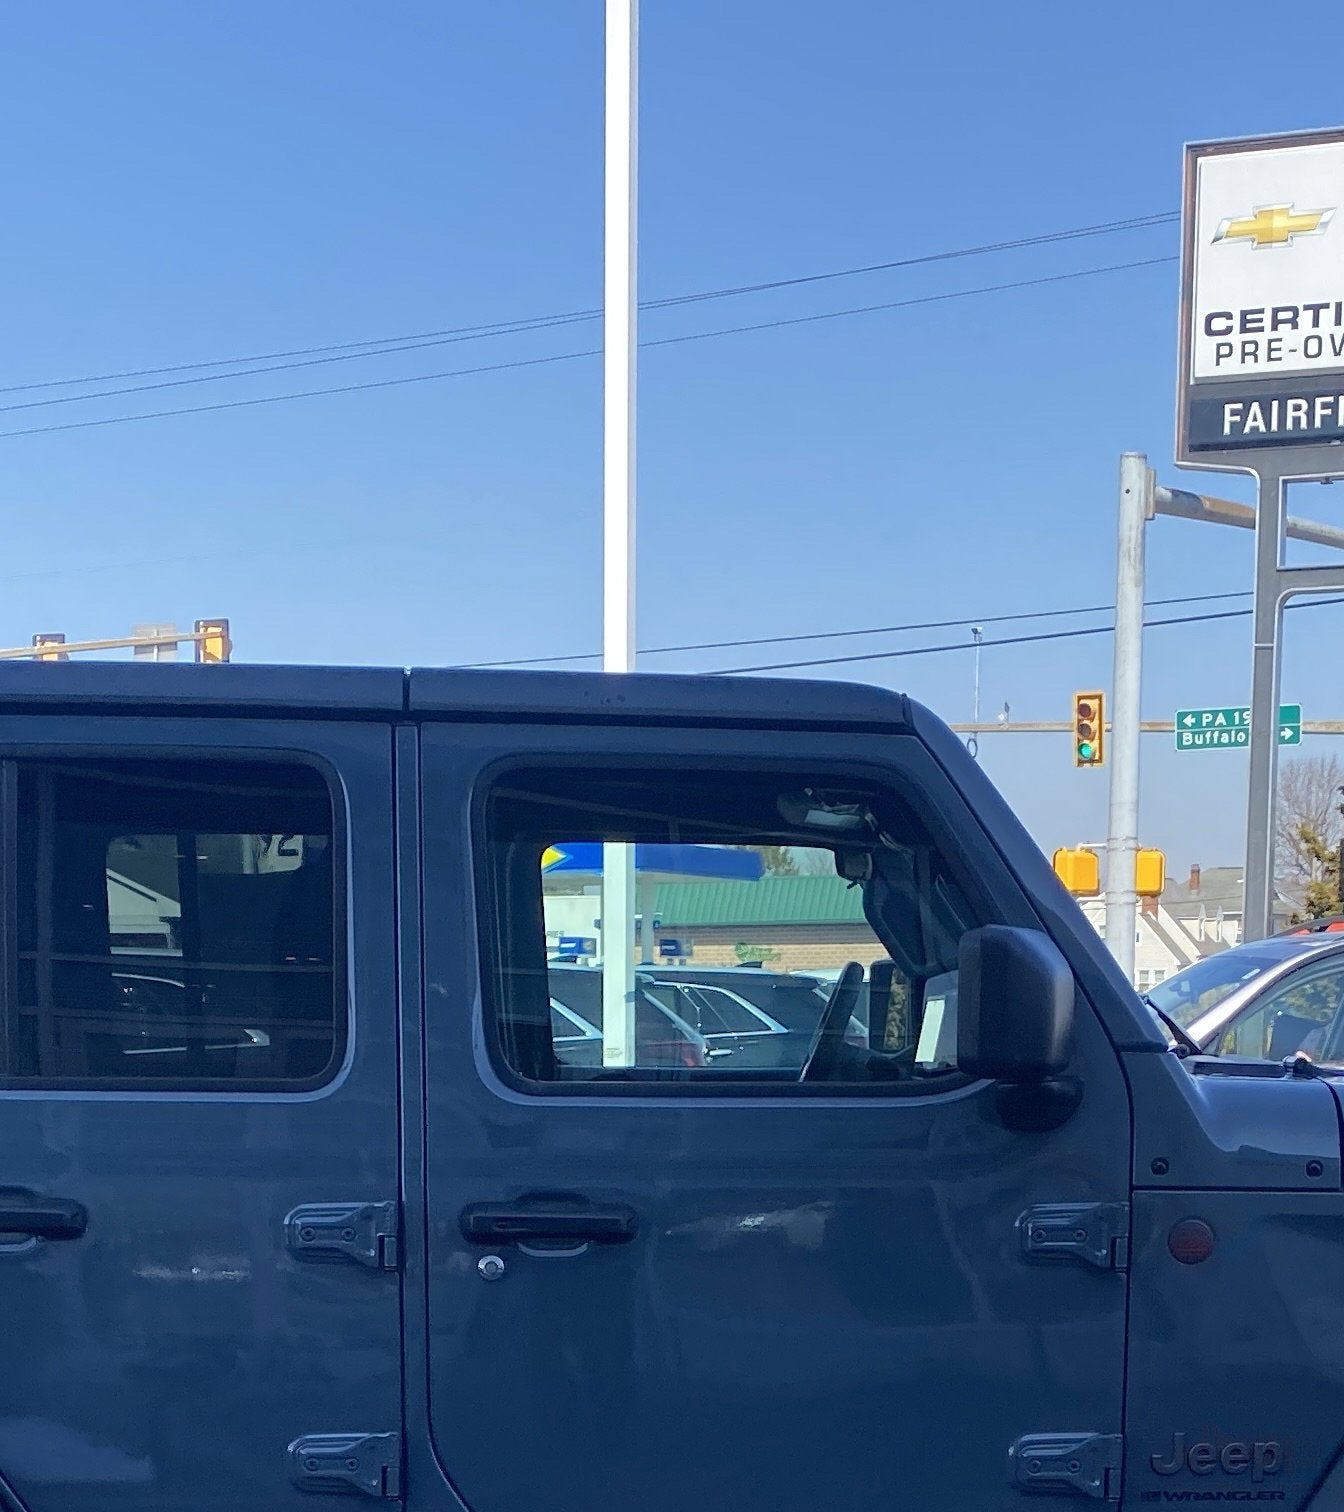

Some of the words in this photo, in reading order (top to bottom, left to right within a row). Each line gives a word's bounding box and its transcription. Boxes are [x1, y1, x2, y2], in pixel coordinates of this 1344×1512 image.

[1202, 712, 1227, 727] PA
[1182, 730, 1246, 746] Buffalo
[1150, 1432, 1281, 1483] Jeep
[1162, 1489, 1286, 1501] WRANGLER
